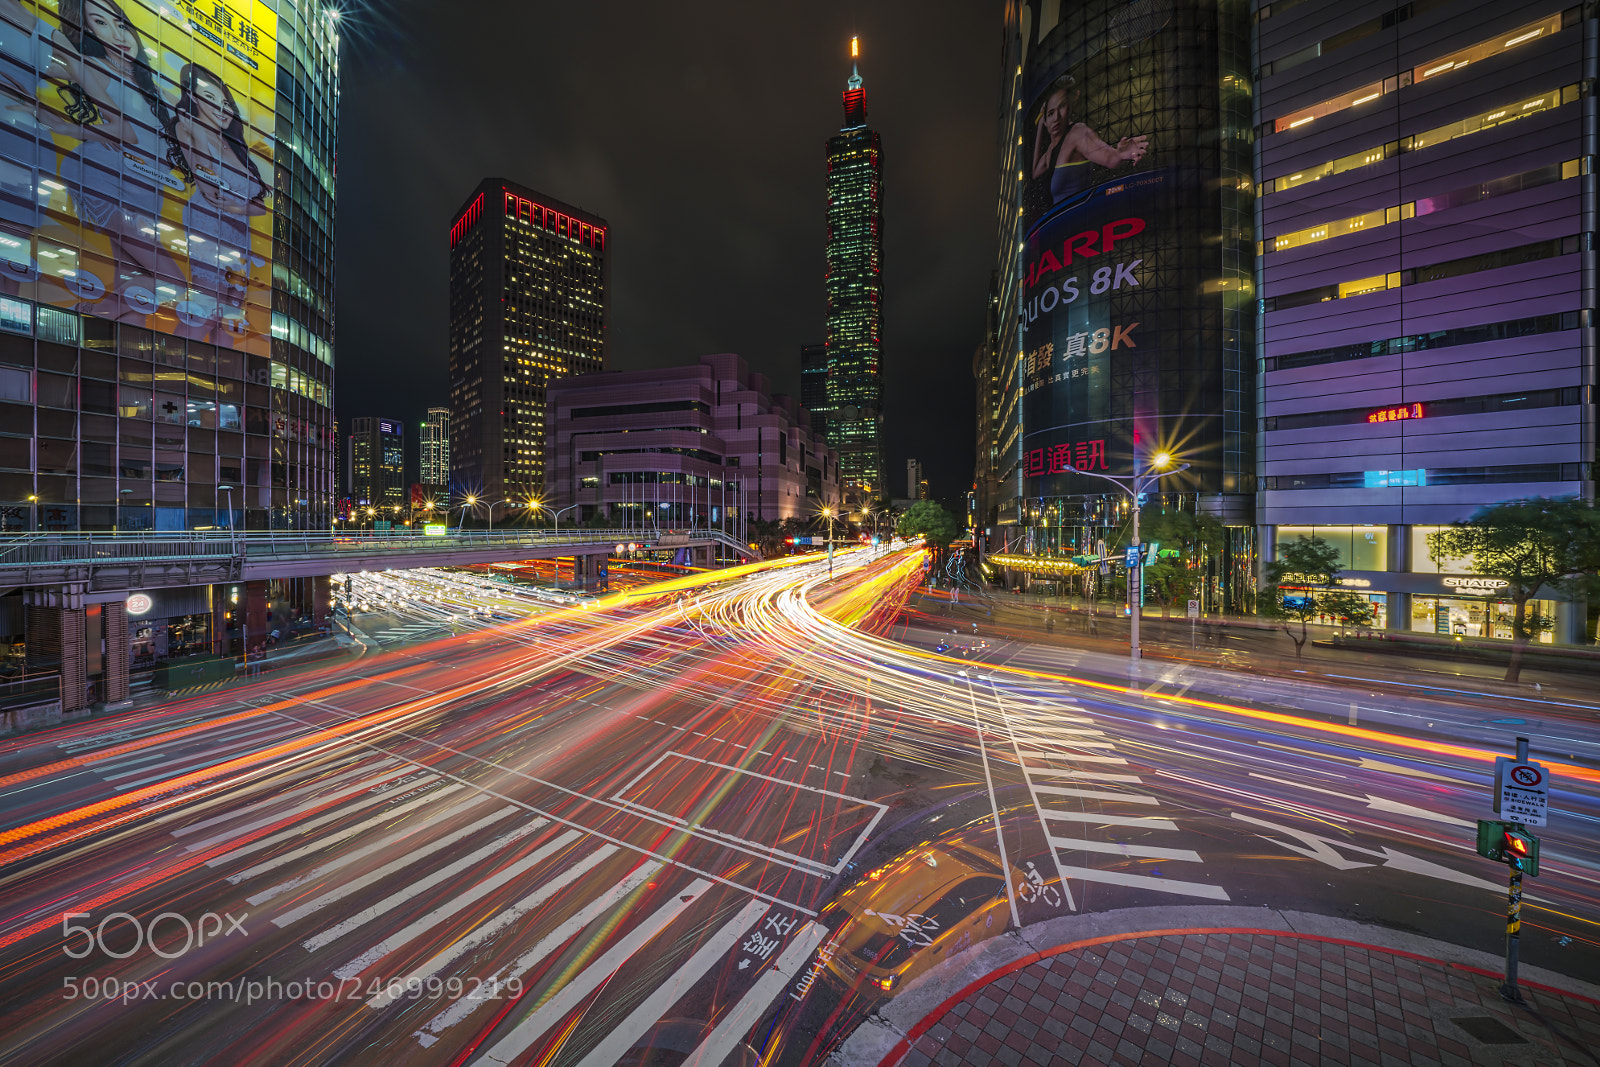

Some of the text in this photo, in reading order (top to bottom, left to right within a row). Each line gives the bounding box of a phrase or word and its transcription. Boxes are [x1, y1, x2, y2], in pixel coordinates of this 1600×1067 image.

[1090, 259, 1143, 295] 8K
[1444, 578, 1508, 588] SHARP
[1511, 798, 1545, 808] SIDEWALK
